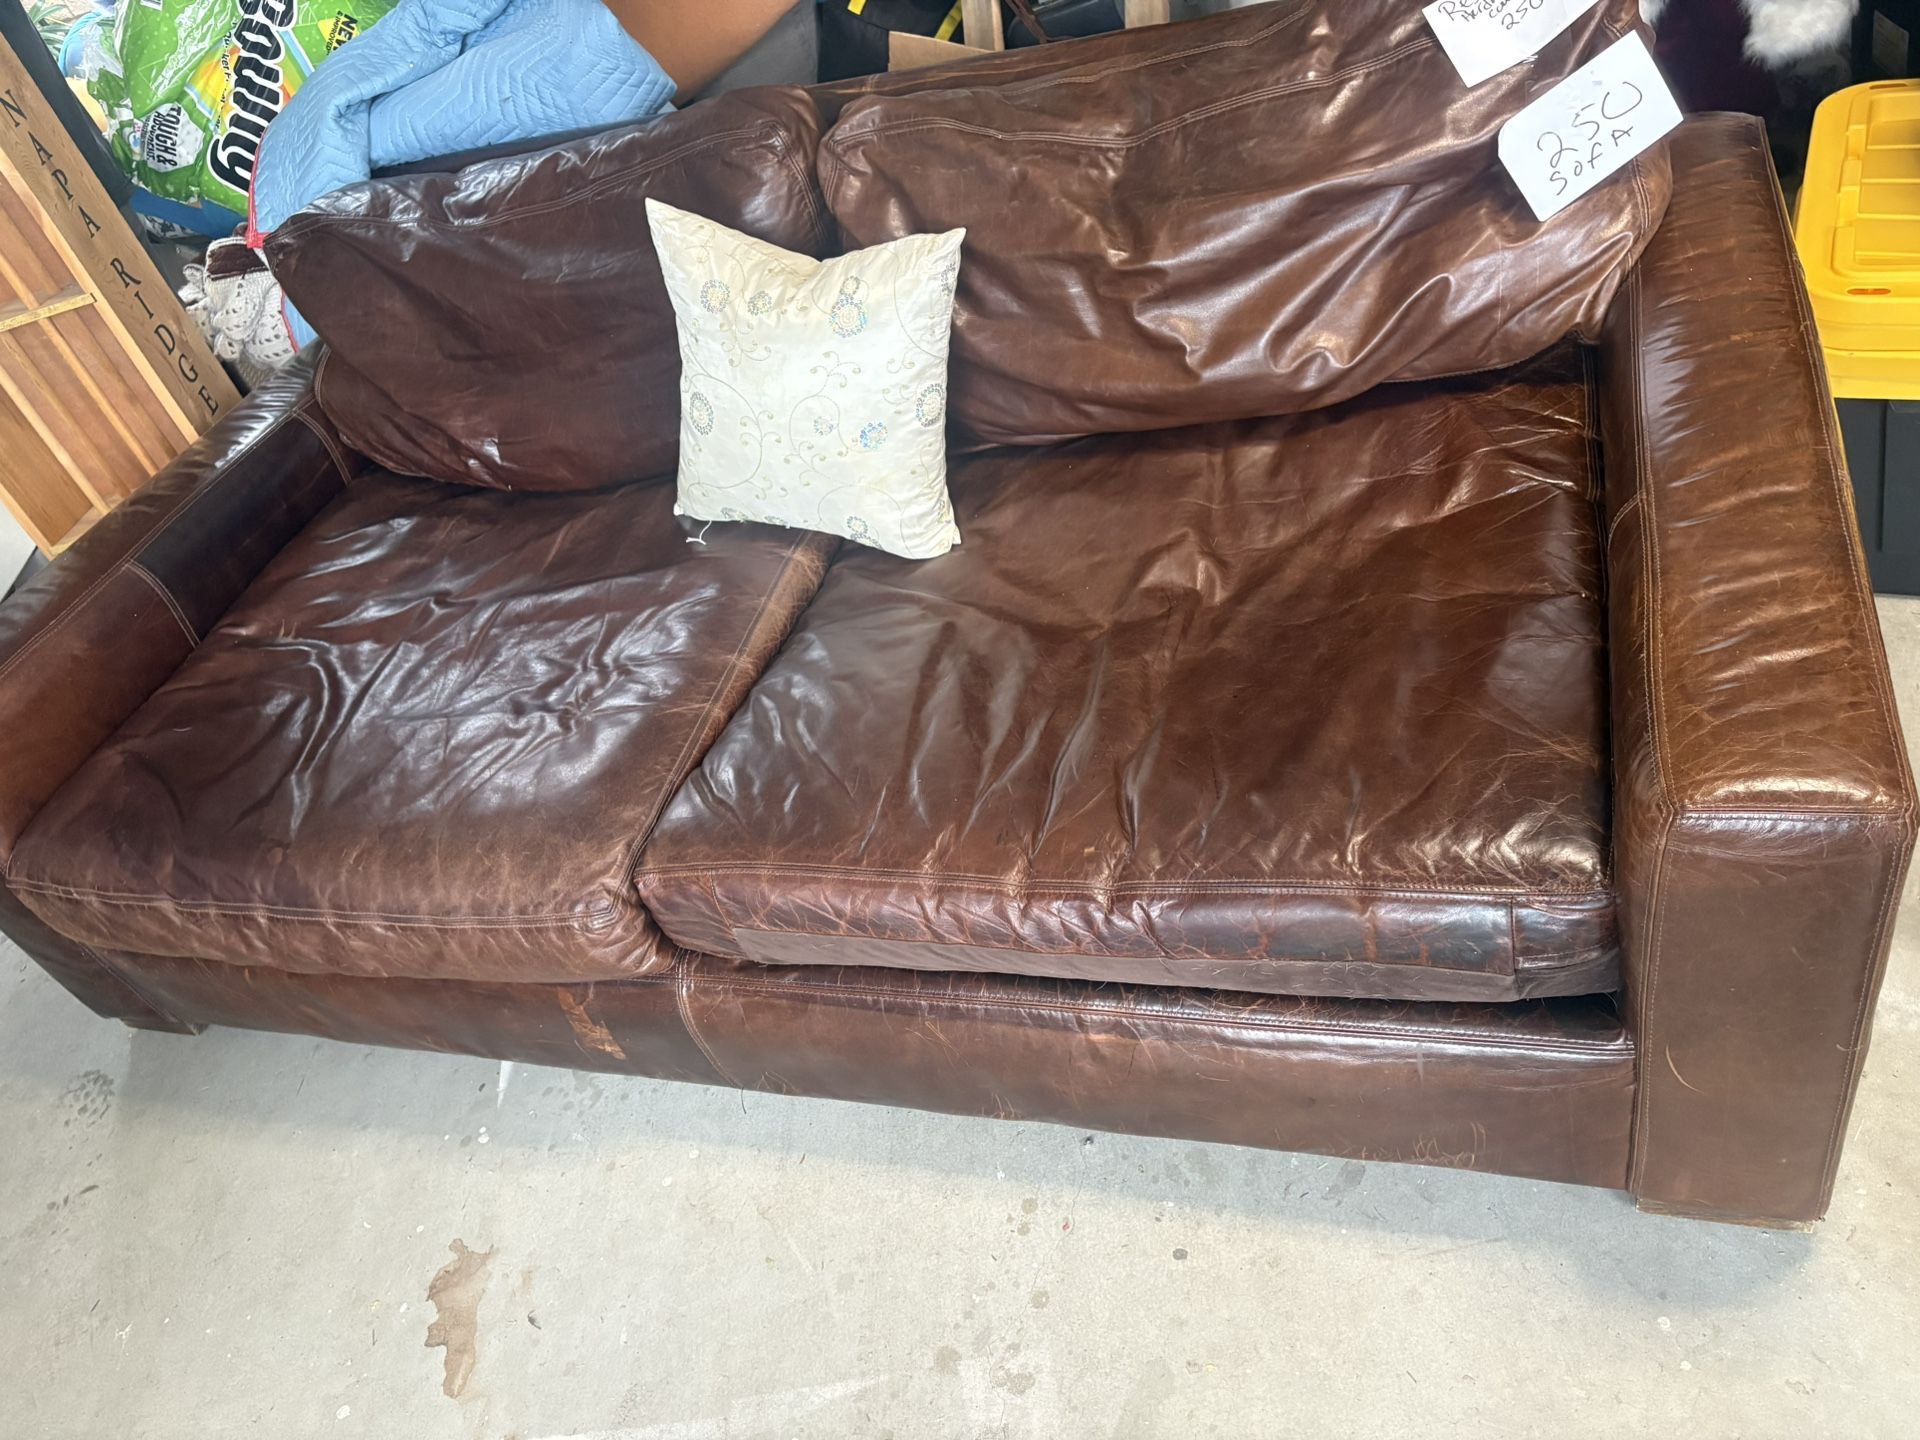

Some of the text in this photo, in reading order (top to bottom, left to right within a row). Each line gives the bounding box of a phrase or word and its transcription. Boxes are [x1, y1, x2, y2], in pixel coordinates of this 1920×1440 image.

[1437, 0, 1480, 21] Re
[155, 105, 182, 167] TOUGH &
[1537, 81, 1642, 168] 250
[0, 89, 219, 416] NAPA RIDGE
